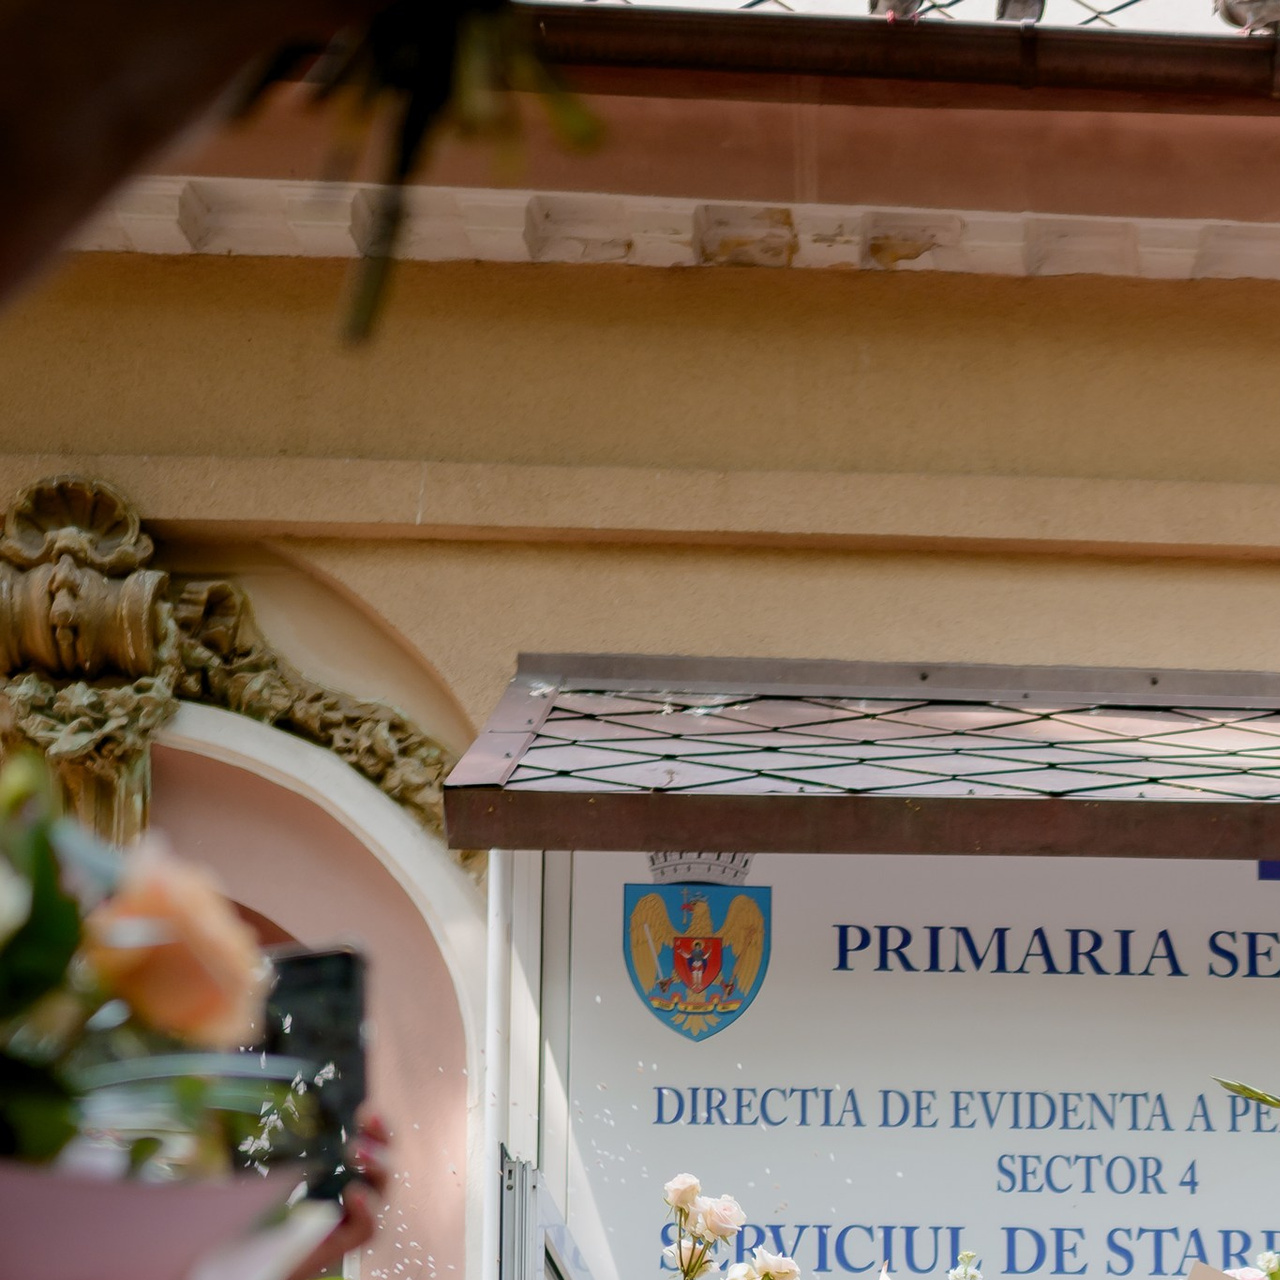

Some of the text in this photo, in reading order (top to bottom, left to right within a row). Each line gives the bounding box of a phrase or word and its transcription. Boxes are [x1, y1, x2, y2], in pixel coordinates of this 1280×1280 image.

[832, 923, 1190, 977] PRIMARIA
[652, 1086, 867, 1127] DIRECTIA
[878, 1089, 940, 1129] DE
[949, 1090, 1175, 1132] EVIDENTA
[1185, 1092, 1217, 1133] A
[996, 1153, 1200, 1195] SECTOR 4
[659, 1222, 984, 1275] SRVICIUL
[1000, 1226, 1089, 1276] DE
